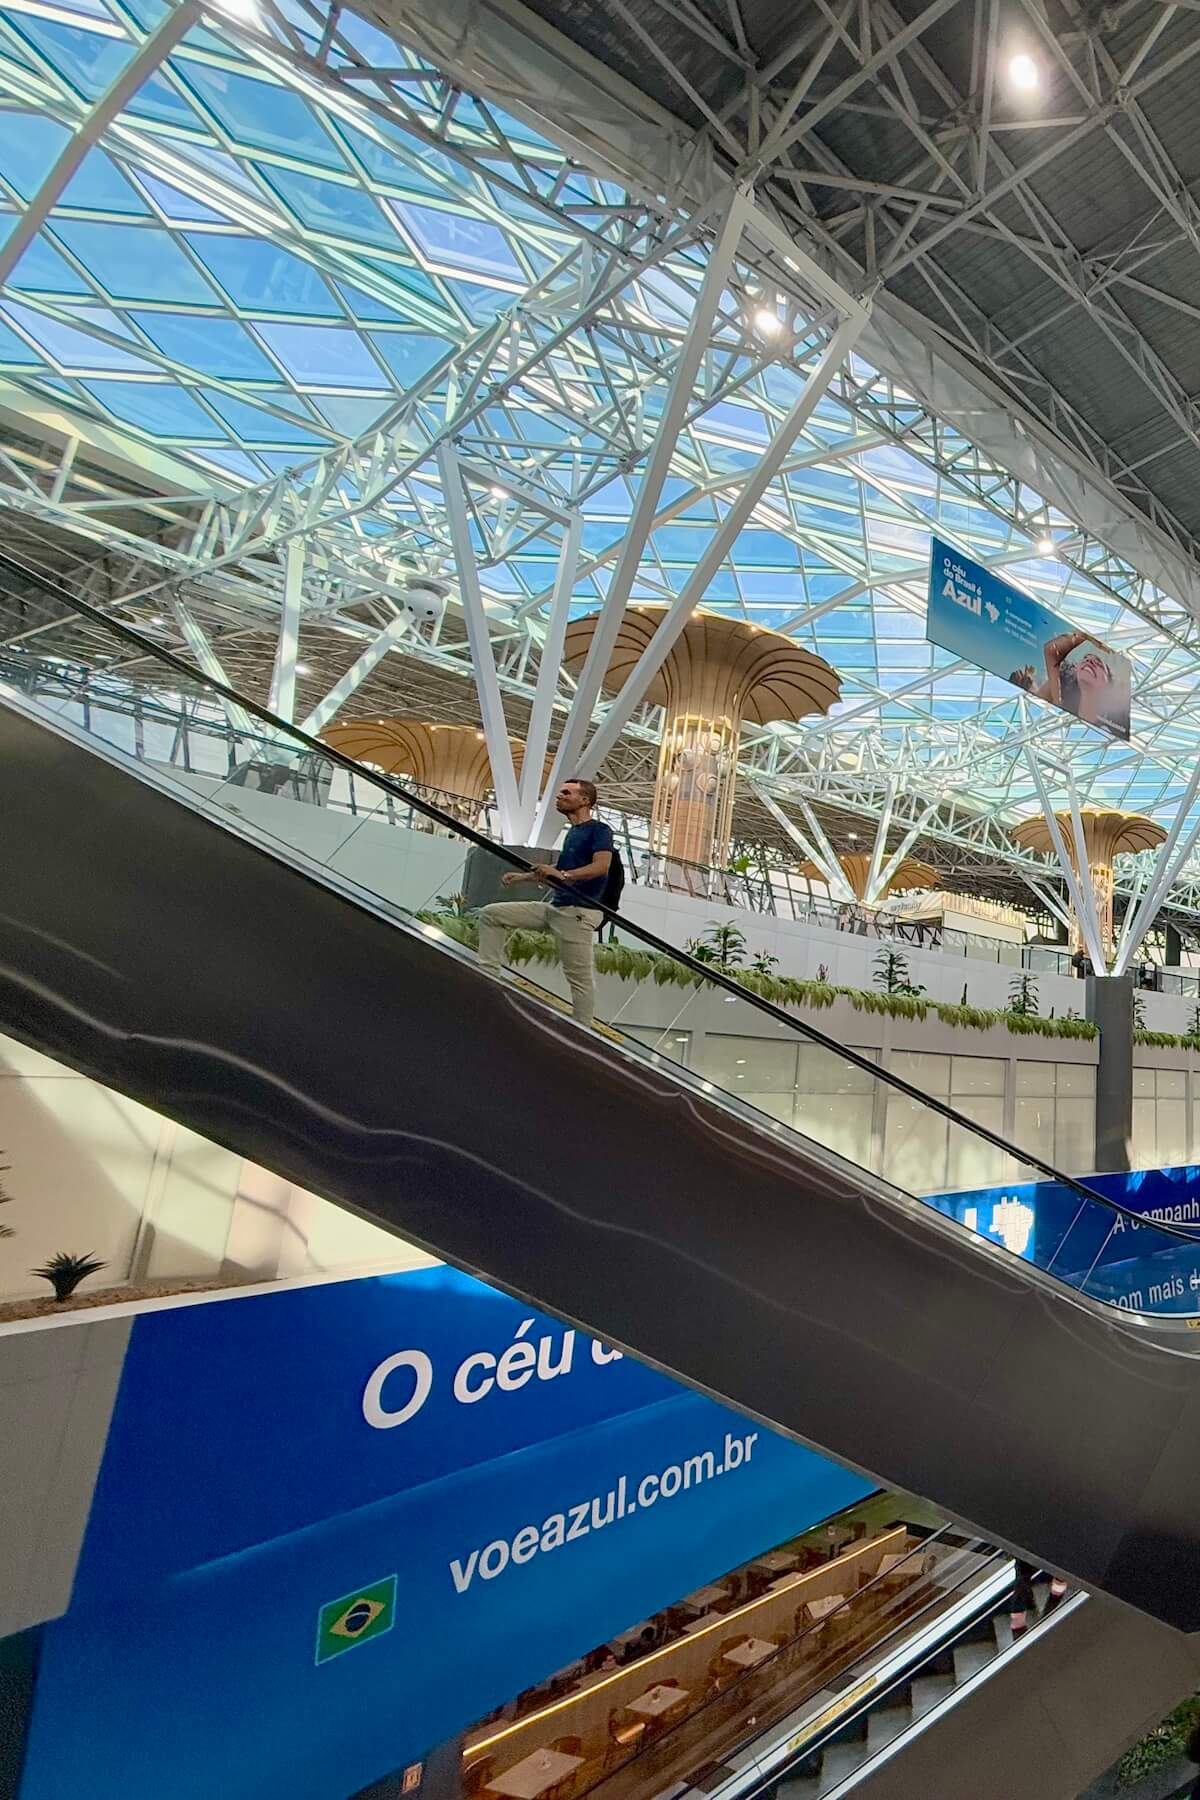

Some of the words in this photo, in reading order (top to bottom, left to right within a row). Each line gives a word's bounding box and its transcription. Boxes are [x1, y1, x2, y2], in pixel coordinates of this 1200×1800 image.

[943, 558, 952, 568] O
[943, 568, 954, 579] do
[942, 579, 982, 617] Azul
[1113, 1213, 1126, 1235] A
[1149, 1274, 1185, 1304] mais
[361, 1349, 434, 1431] O
[453, 1318, 576, 1404] céu
[448, 1432, 759, 1595] voeazul.com.br
